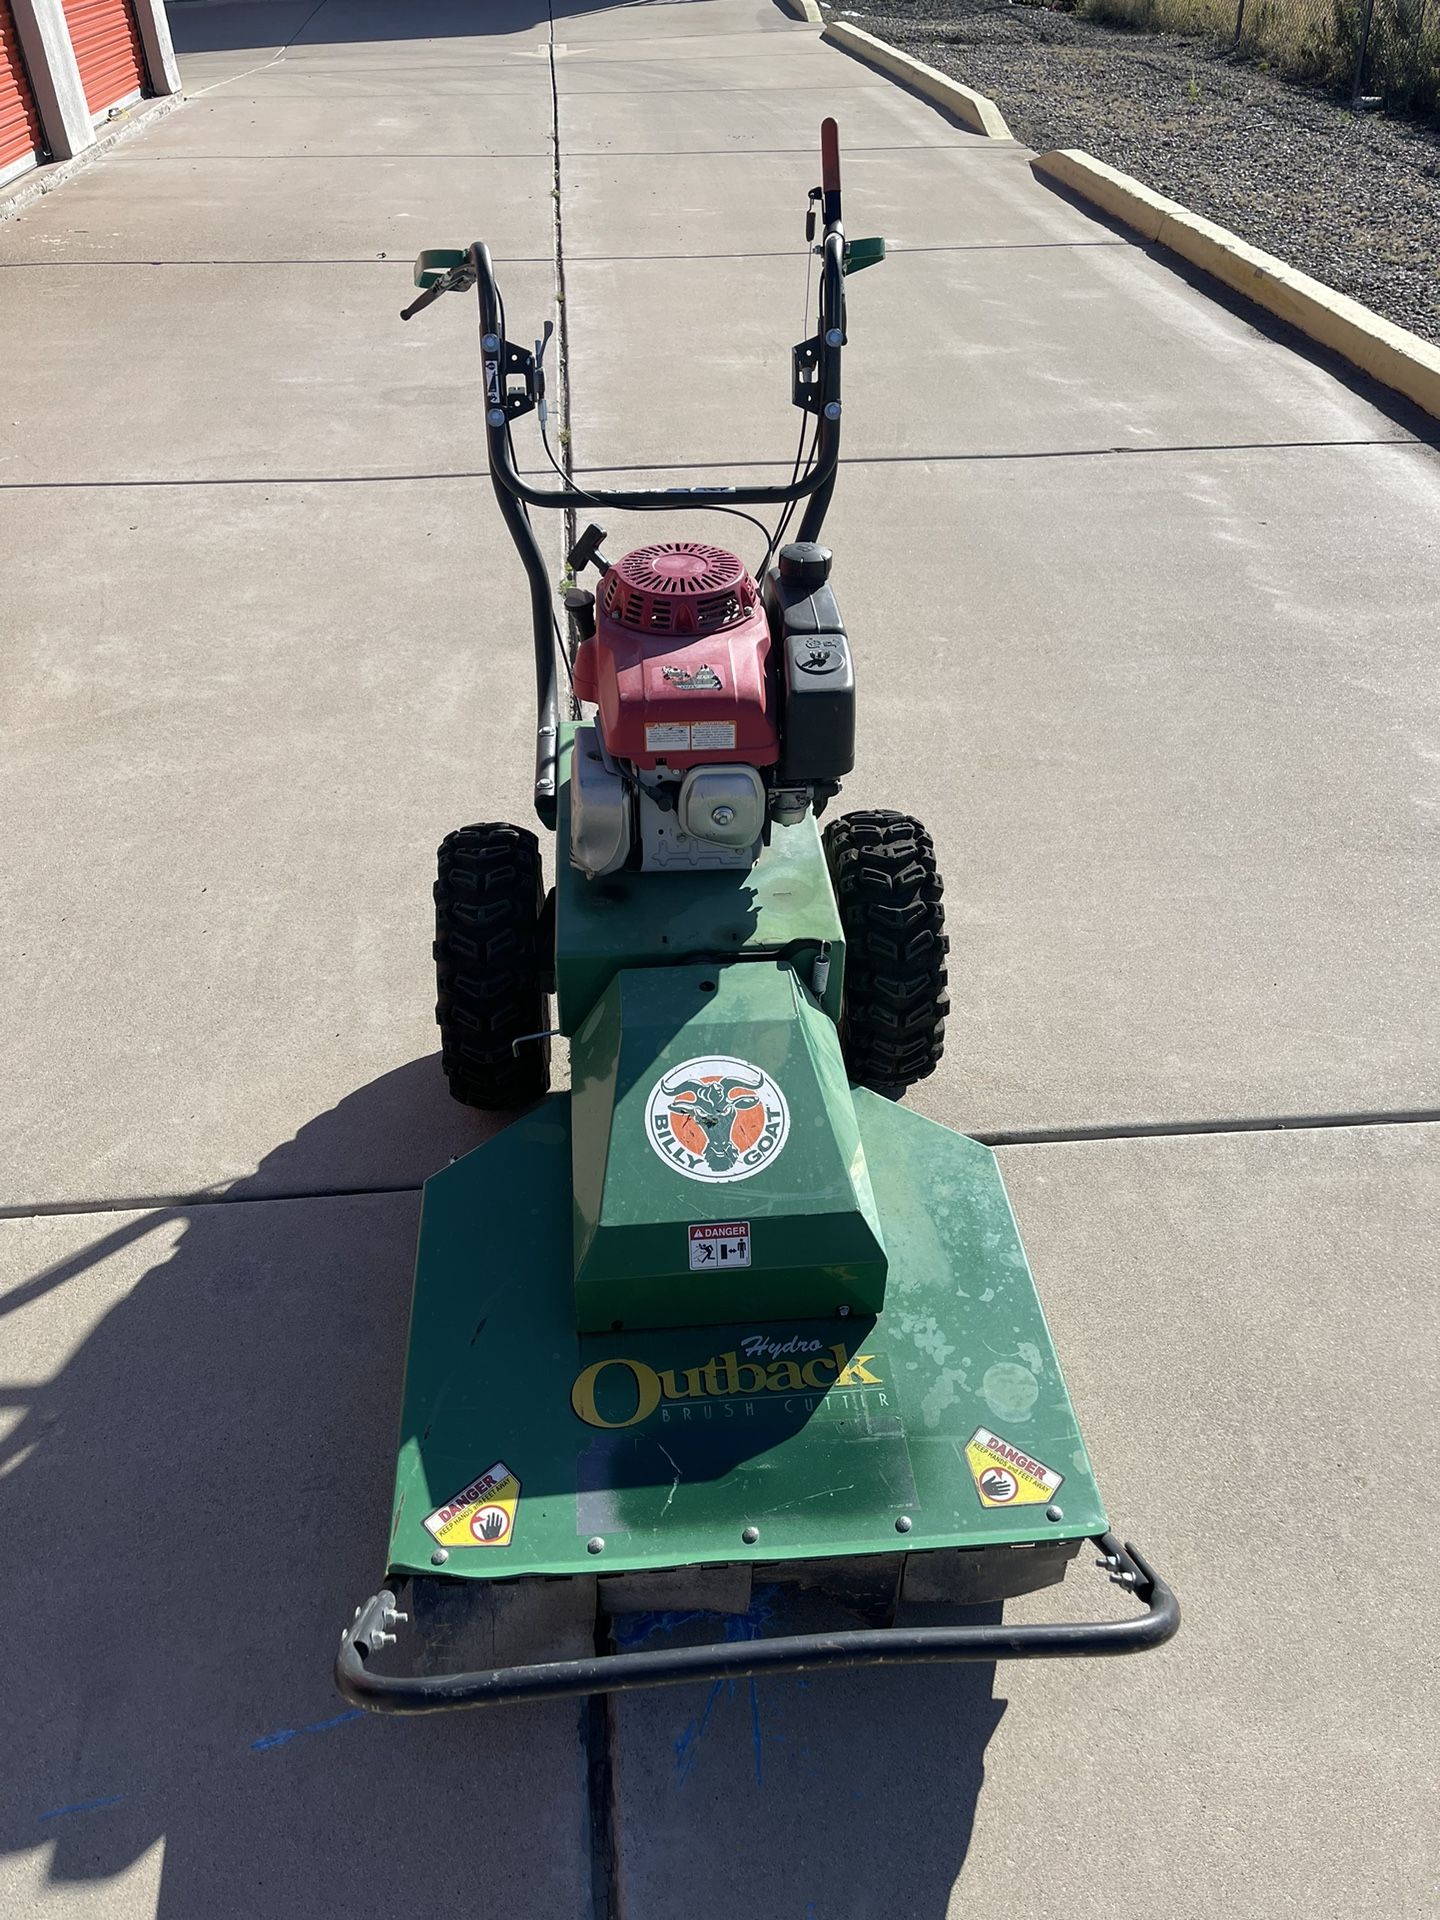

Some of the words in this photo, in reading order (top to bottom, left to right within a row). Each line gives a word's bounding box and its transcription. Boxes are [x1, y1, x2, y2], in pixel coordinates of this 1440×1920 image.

[654, 1114, 705, 1169] BILLY
[743, 1106, 780, 1166] GOAT
[704, 1226, 746, 1237] DANGER
[741, 1335, 824, 1360] Hydro
[571, 1343, 884, 1429] Outback
[661, 1402, 755, 1423] BRUSH
[973, 1443, 988, 1454] KEEP
[987, 1450, 1007, 1467] HANDS
[1007, 1463, 1018, 1474] and
[1018, 1470, 1033, 1485] FEET
[1033, 1480, 1049, 1493] AWAY
[986, 1437, 1047, 1481] DANGER
[438, 1474, 498, 1523] DANGER
[439, 1523, 454, 1537] KEEP
[454, 1509, 473, 1526] HANDS
[482, 1490, 497, 1505] FEET
[496, 1478, 511, 1492] AWAY
